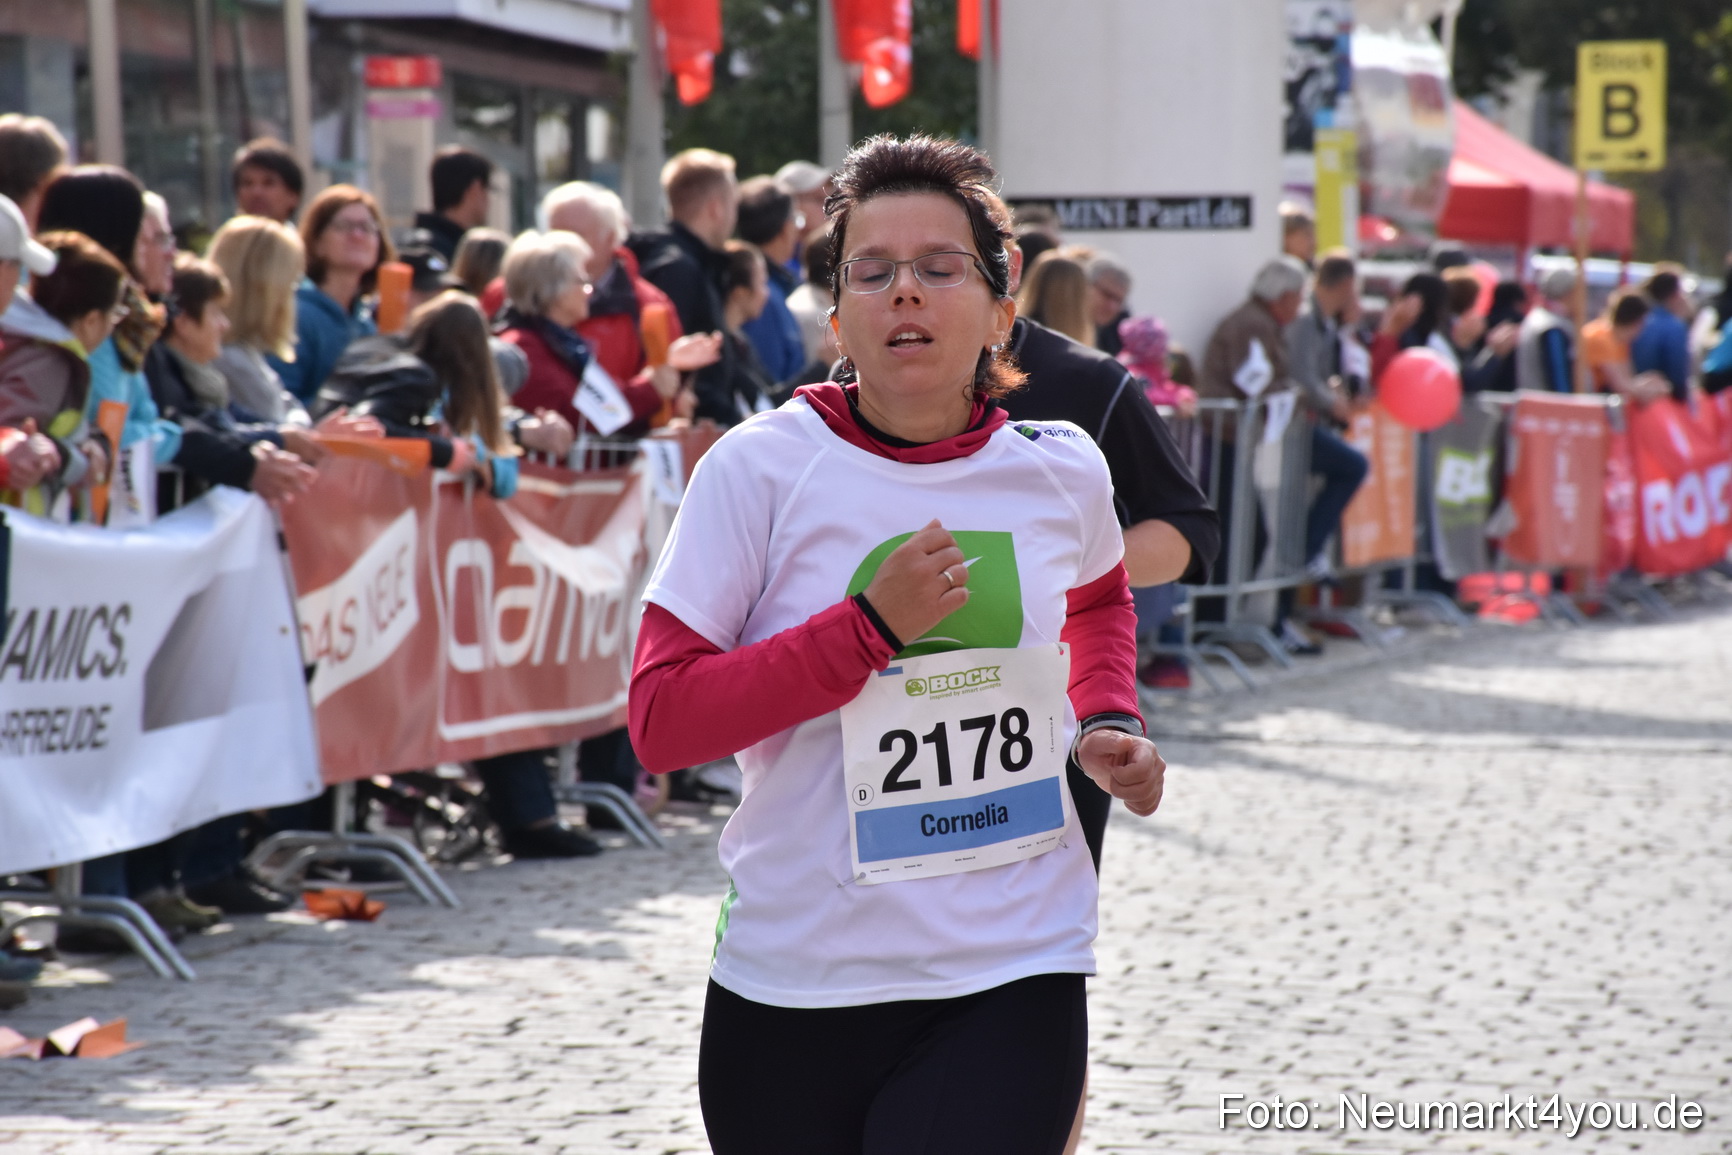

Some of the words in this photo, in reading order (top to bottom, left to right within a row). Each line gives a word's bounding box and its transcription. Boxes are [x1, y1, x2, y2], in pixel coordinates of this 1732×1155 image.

[1602, 84, 1641, 139] B
[928, 666, 1001, 694] BOCK
[930, 692, 953, 700] inspired
[979, 682, 1001, 691] concepts
[879, 707, 1033, 793] 2178
[858, 789, 867, 801] D
[920, 803, 1009, 837] Cornelia
